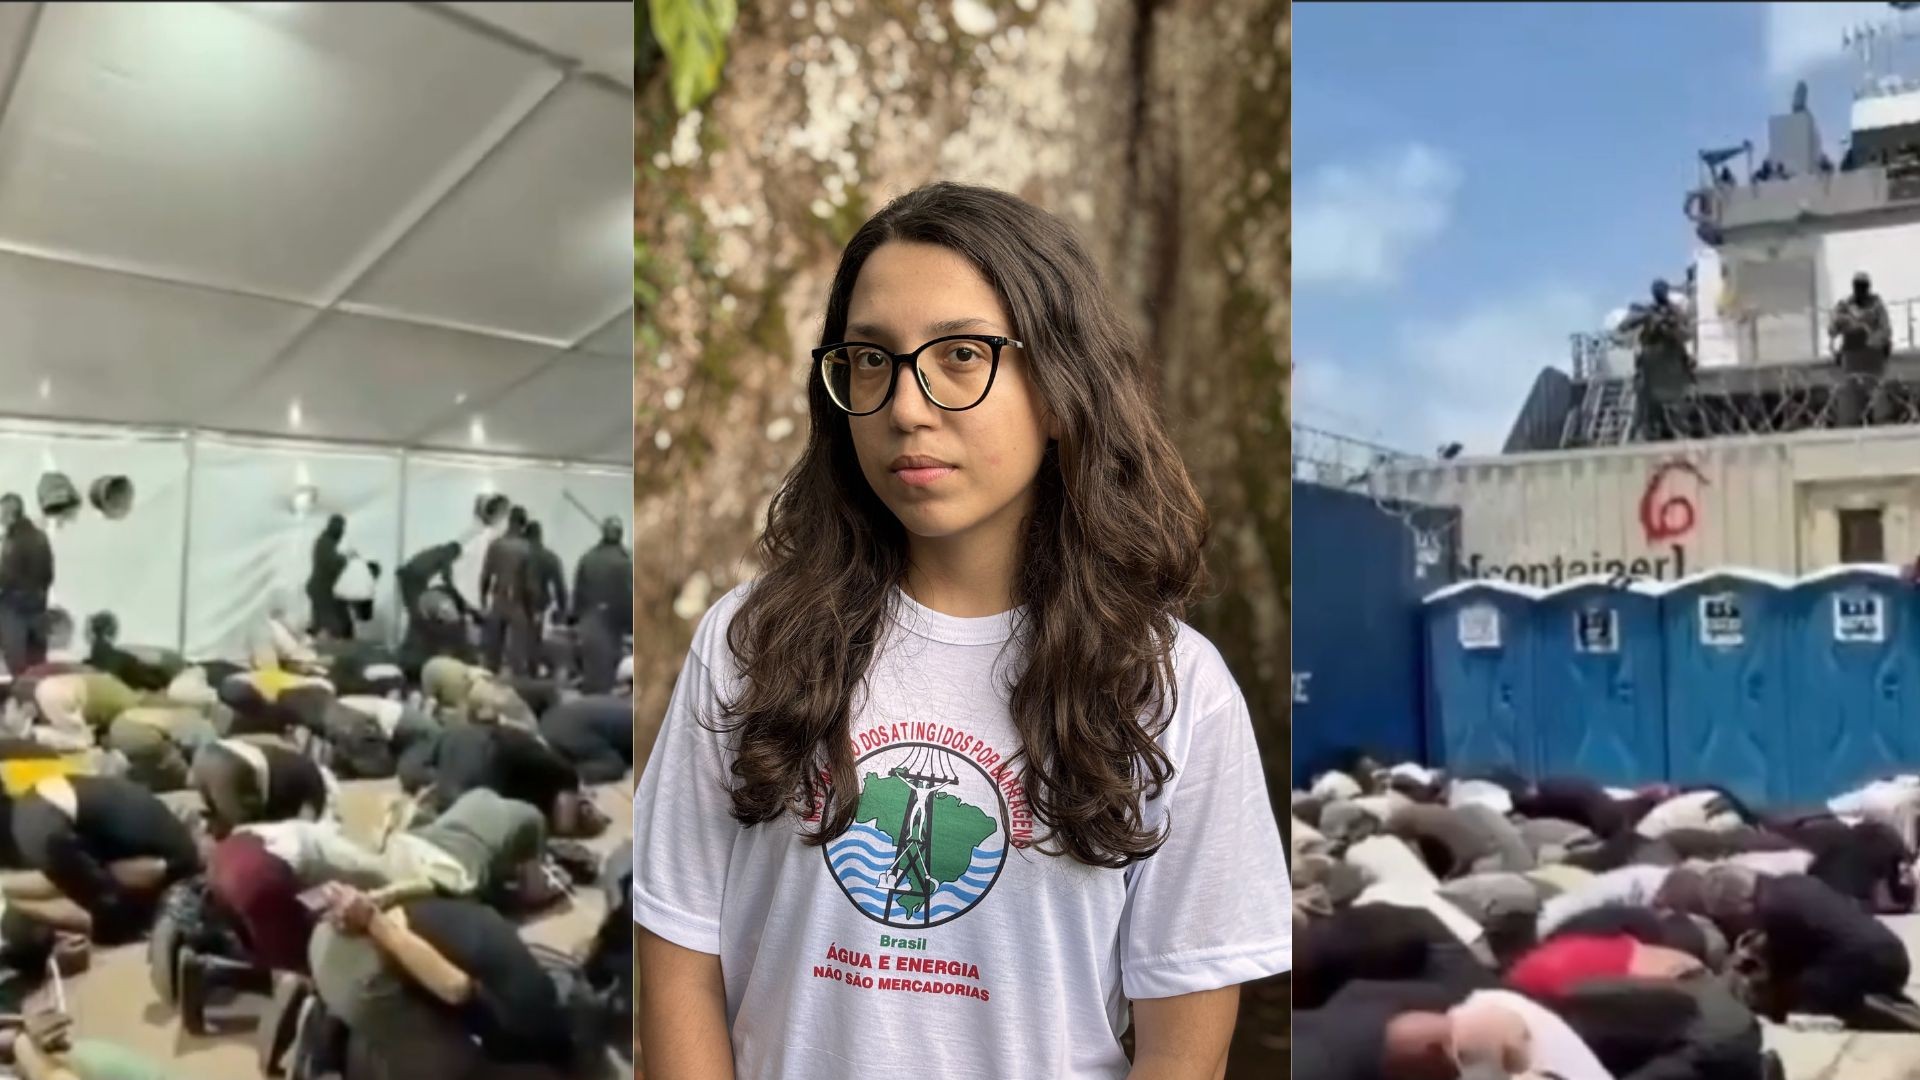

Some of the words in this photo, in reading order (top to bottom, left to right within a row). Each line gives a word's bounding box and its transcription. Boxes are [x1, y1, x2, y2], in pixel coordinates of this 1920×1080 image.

[1640, 461, 1711, 542] 6
[859, 725, 890, 751] DOS
[891, 721, 973, 753] ATINGIDOS
[969, 740, 1000, 769] POR
[826, 942, 873, 969] ÁGUA
[878, 955, 891, 970] E
[896, 956, 980, 980] ENERGIA
[880, 934, 927, 951] Brasil
[813, 964, 842, 981] NÃO
[845, 972, 874, 989] SÃO
[878, 978, 990, 1002] MERCADORIAS
